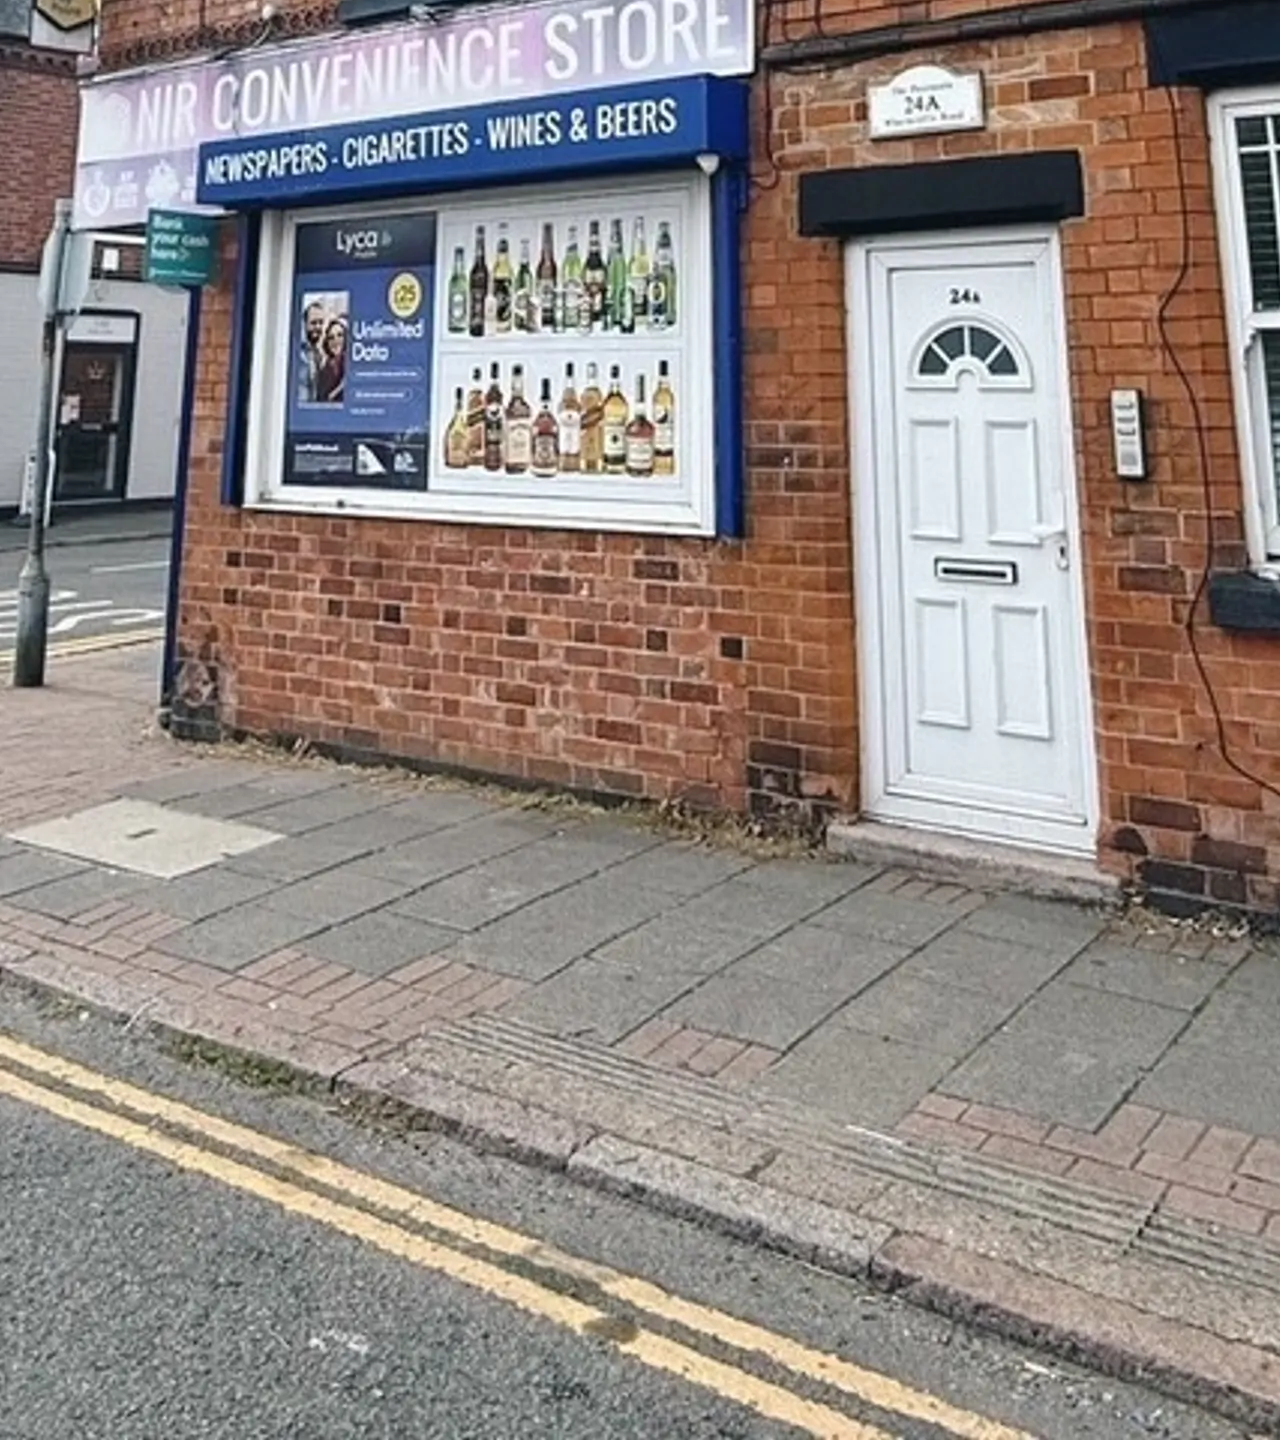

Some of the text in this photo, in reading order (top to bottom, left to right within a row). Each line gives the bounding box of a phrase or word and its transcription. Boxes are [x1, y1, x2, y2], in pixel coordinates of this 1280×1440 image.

[136, 81, 198, 144] NIR
[211, 21, 526, 131] CONVENIENCE
[904, 95, 941, 115] 24A
[205, 142, 328, 185] NEWSPAPERS
[342, 122, 470, 169] CIGARETTES
[486, 109, 562, 150] WINES
[569, 107, 588, 142] &
[596, 97, 678, 140] BEERS
[336, 230, 379, 254] Lyca
[351, 318, 425, 340] Unlimited
[351, 342, 390, 362] Data
